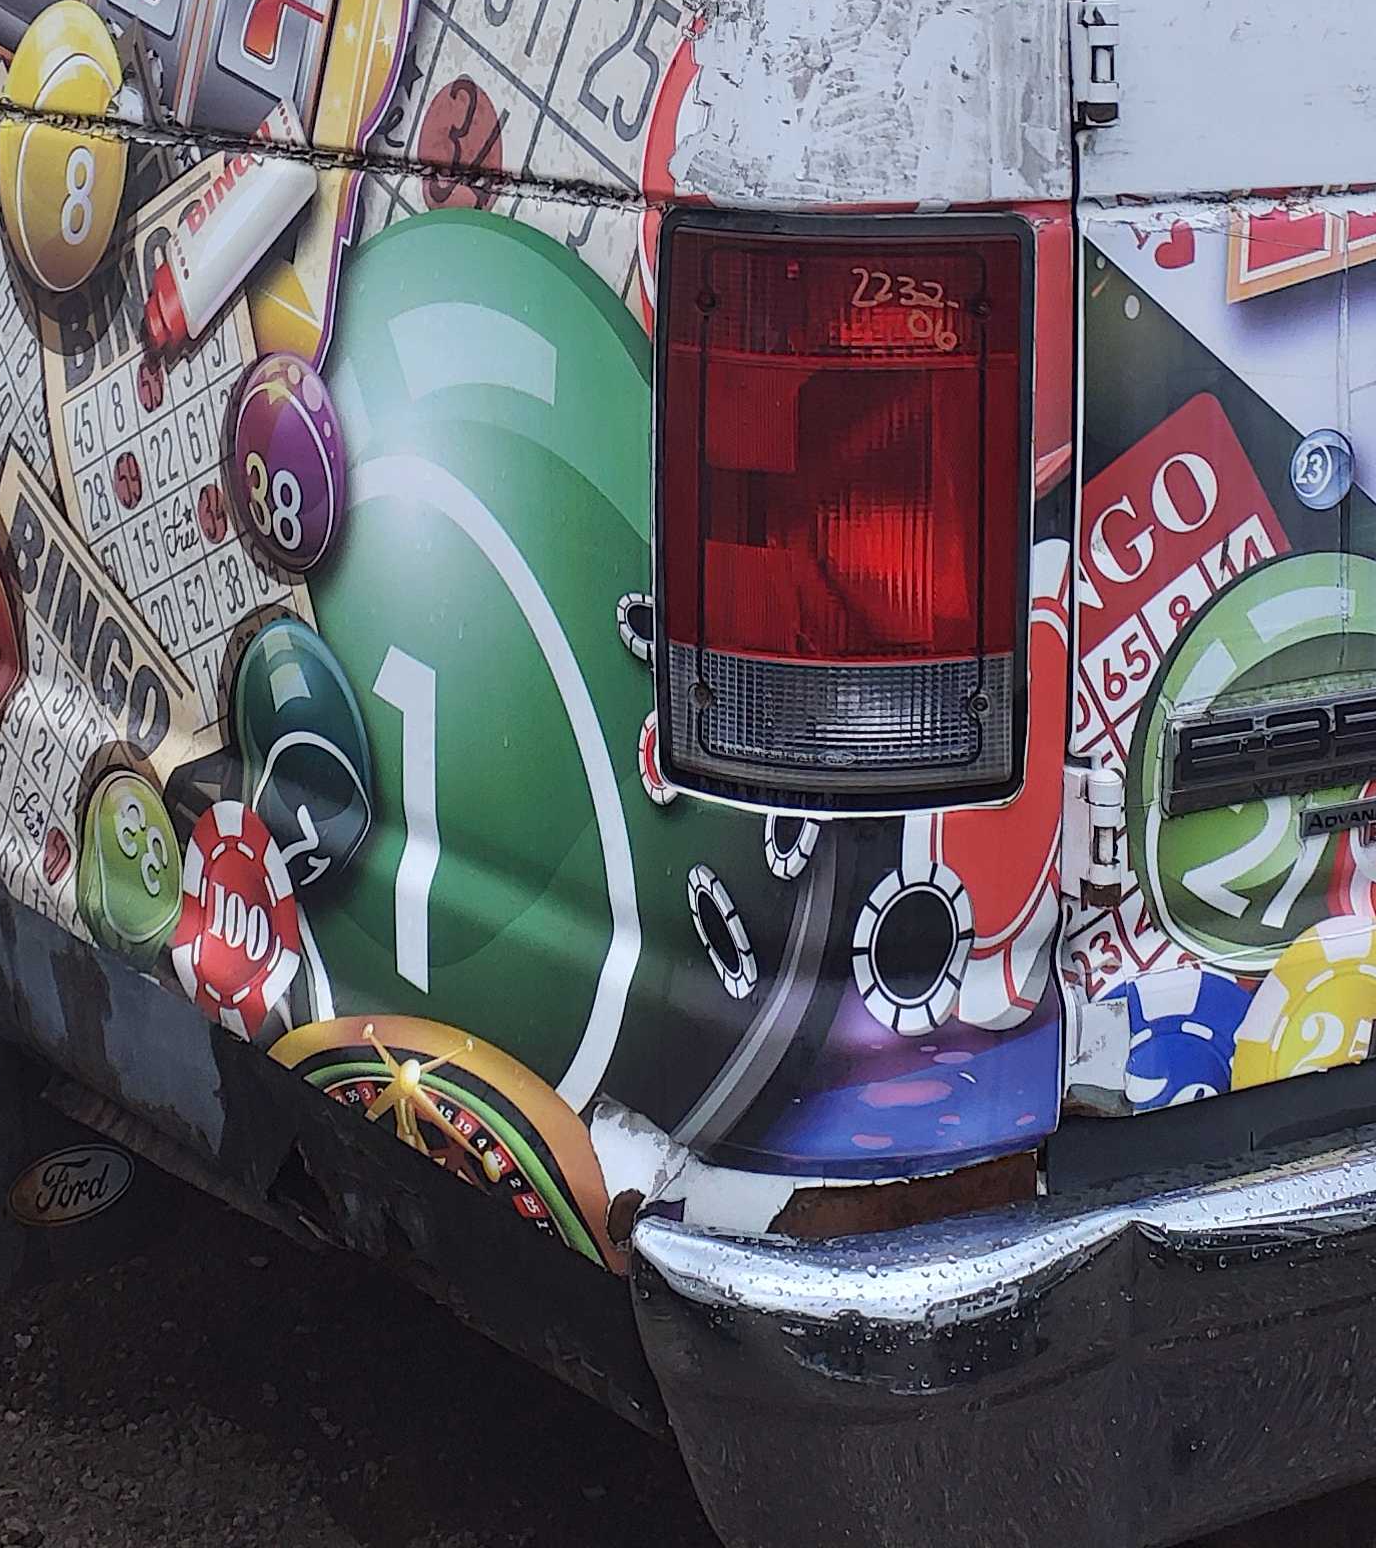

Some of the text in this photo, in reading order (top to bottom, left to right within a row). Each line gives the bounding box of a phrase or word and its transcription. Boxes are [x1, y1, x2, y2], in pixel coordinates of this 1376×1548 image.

[61, 146, 96, 246] 8
[74, 402, 95, 459] 45
[111, 381, 125, 433] 8
[83, 472, 111, 531] 28
[150, 427, 179, 489] 22
[186, 403, 213, 465] 61
[244, 450, 303, 551] 38
[1295, 450, 1326, 489] 23
[132, 521, 160, 579] 15
[8, 501, 171, 761] BINGO
[183, 573, 214, 634] 52
[218, 553, 247, 615] 38
[1103, 632, 1152, 702] 65
[371, 645, 441, 995] 1
[207, 881, 270, 962] 100
[1070, 930, 1124, 1004] 23
[35, 1156, 111, 1214] Ford
[456, 1114, 473, 1134] 19
[476, 1137, 487, 1149] 4
[509, 1177, 522, 1189] 2
[522, 1195, 540, 1215] 25
